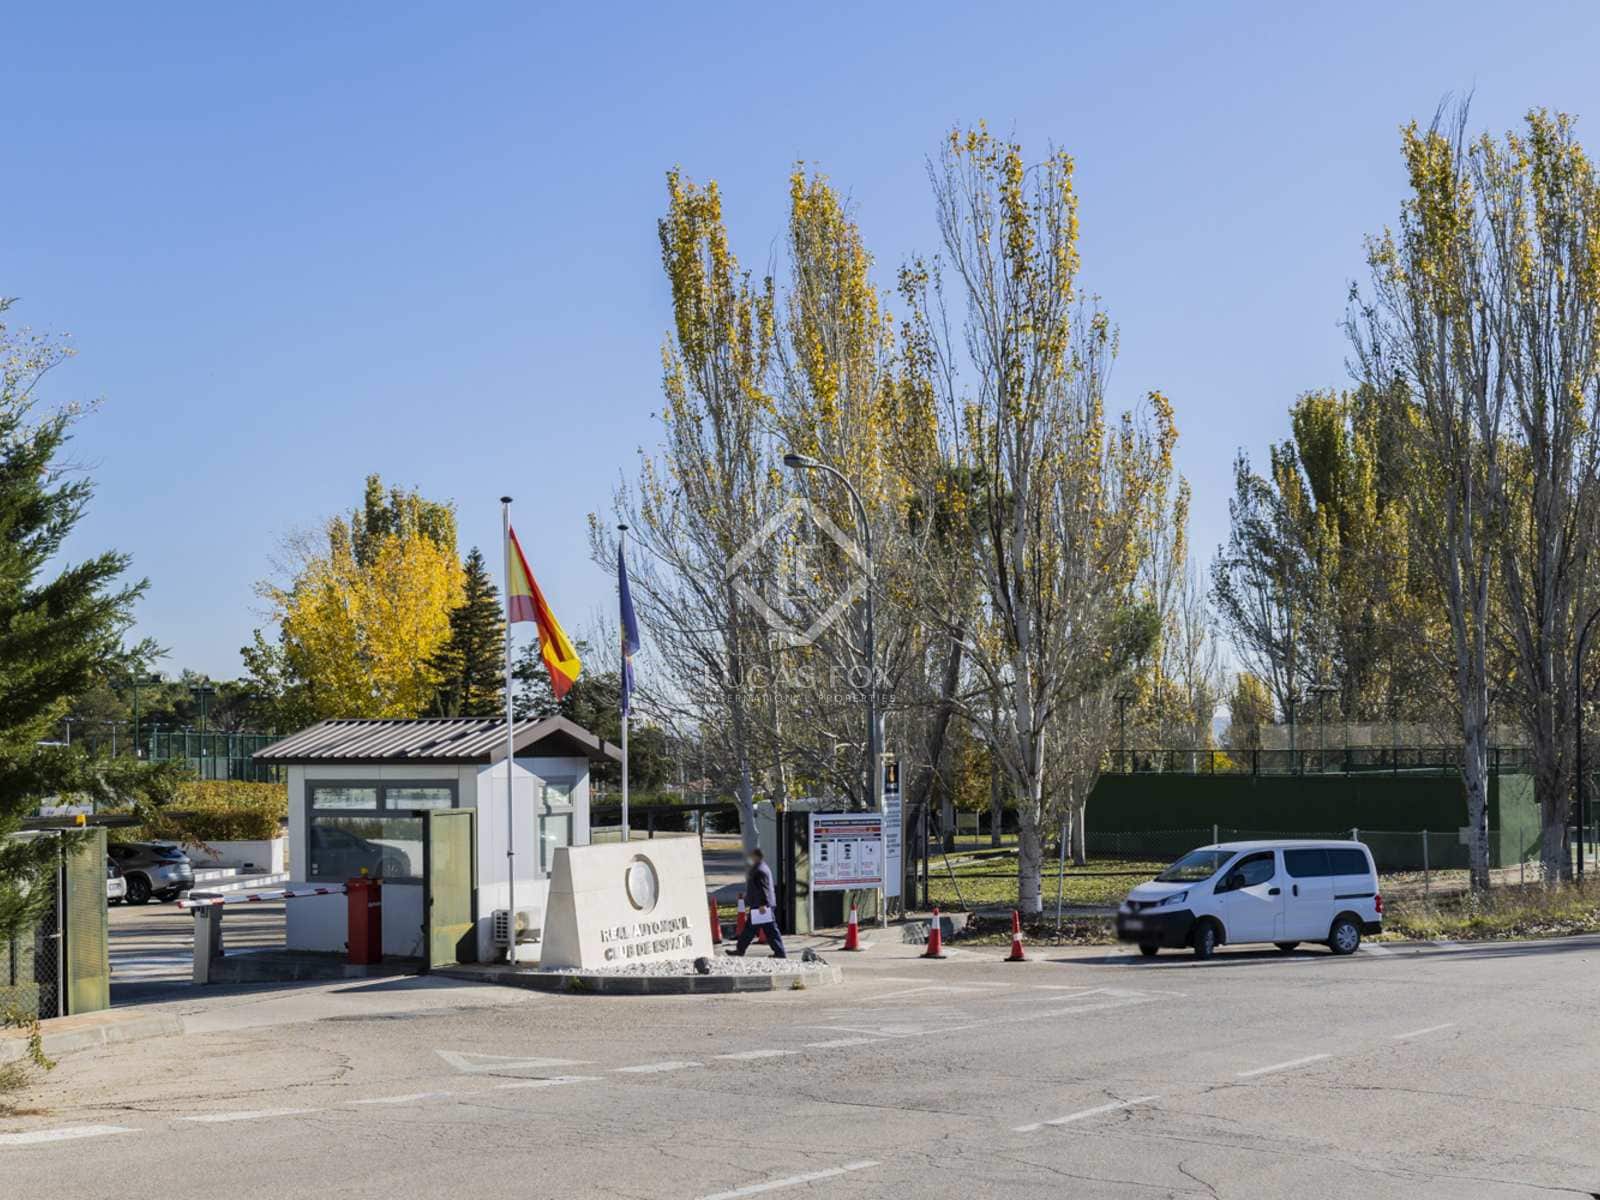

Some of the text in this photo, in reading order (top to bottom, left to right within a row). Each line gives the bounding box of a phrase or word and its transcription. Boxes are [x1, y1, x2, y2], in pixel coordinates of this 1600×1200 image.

[601, 925, 630, 943] REAL
[604, 944, 633, 961] CLUB
[636, 942, 652, 957] DE
